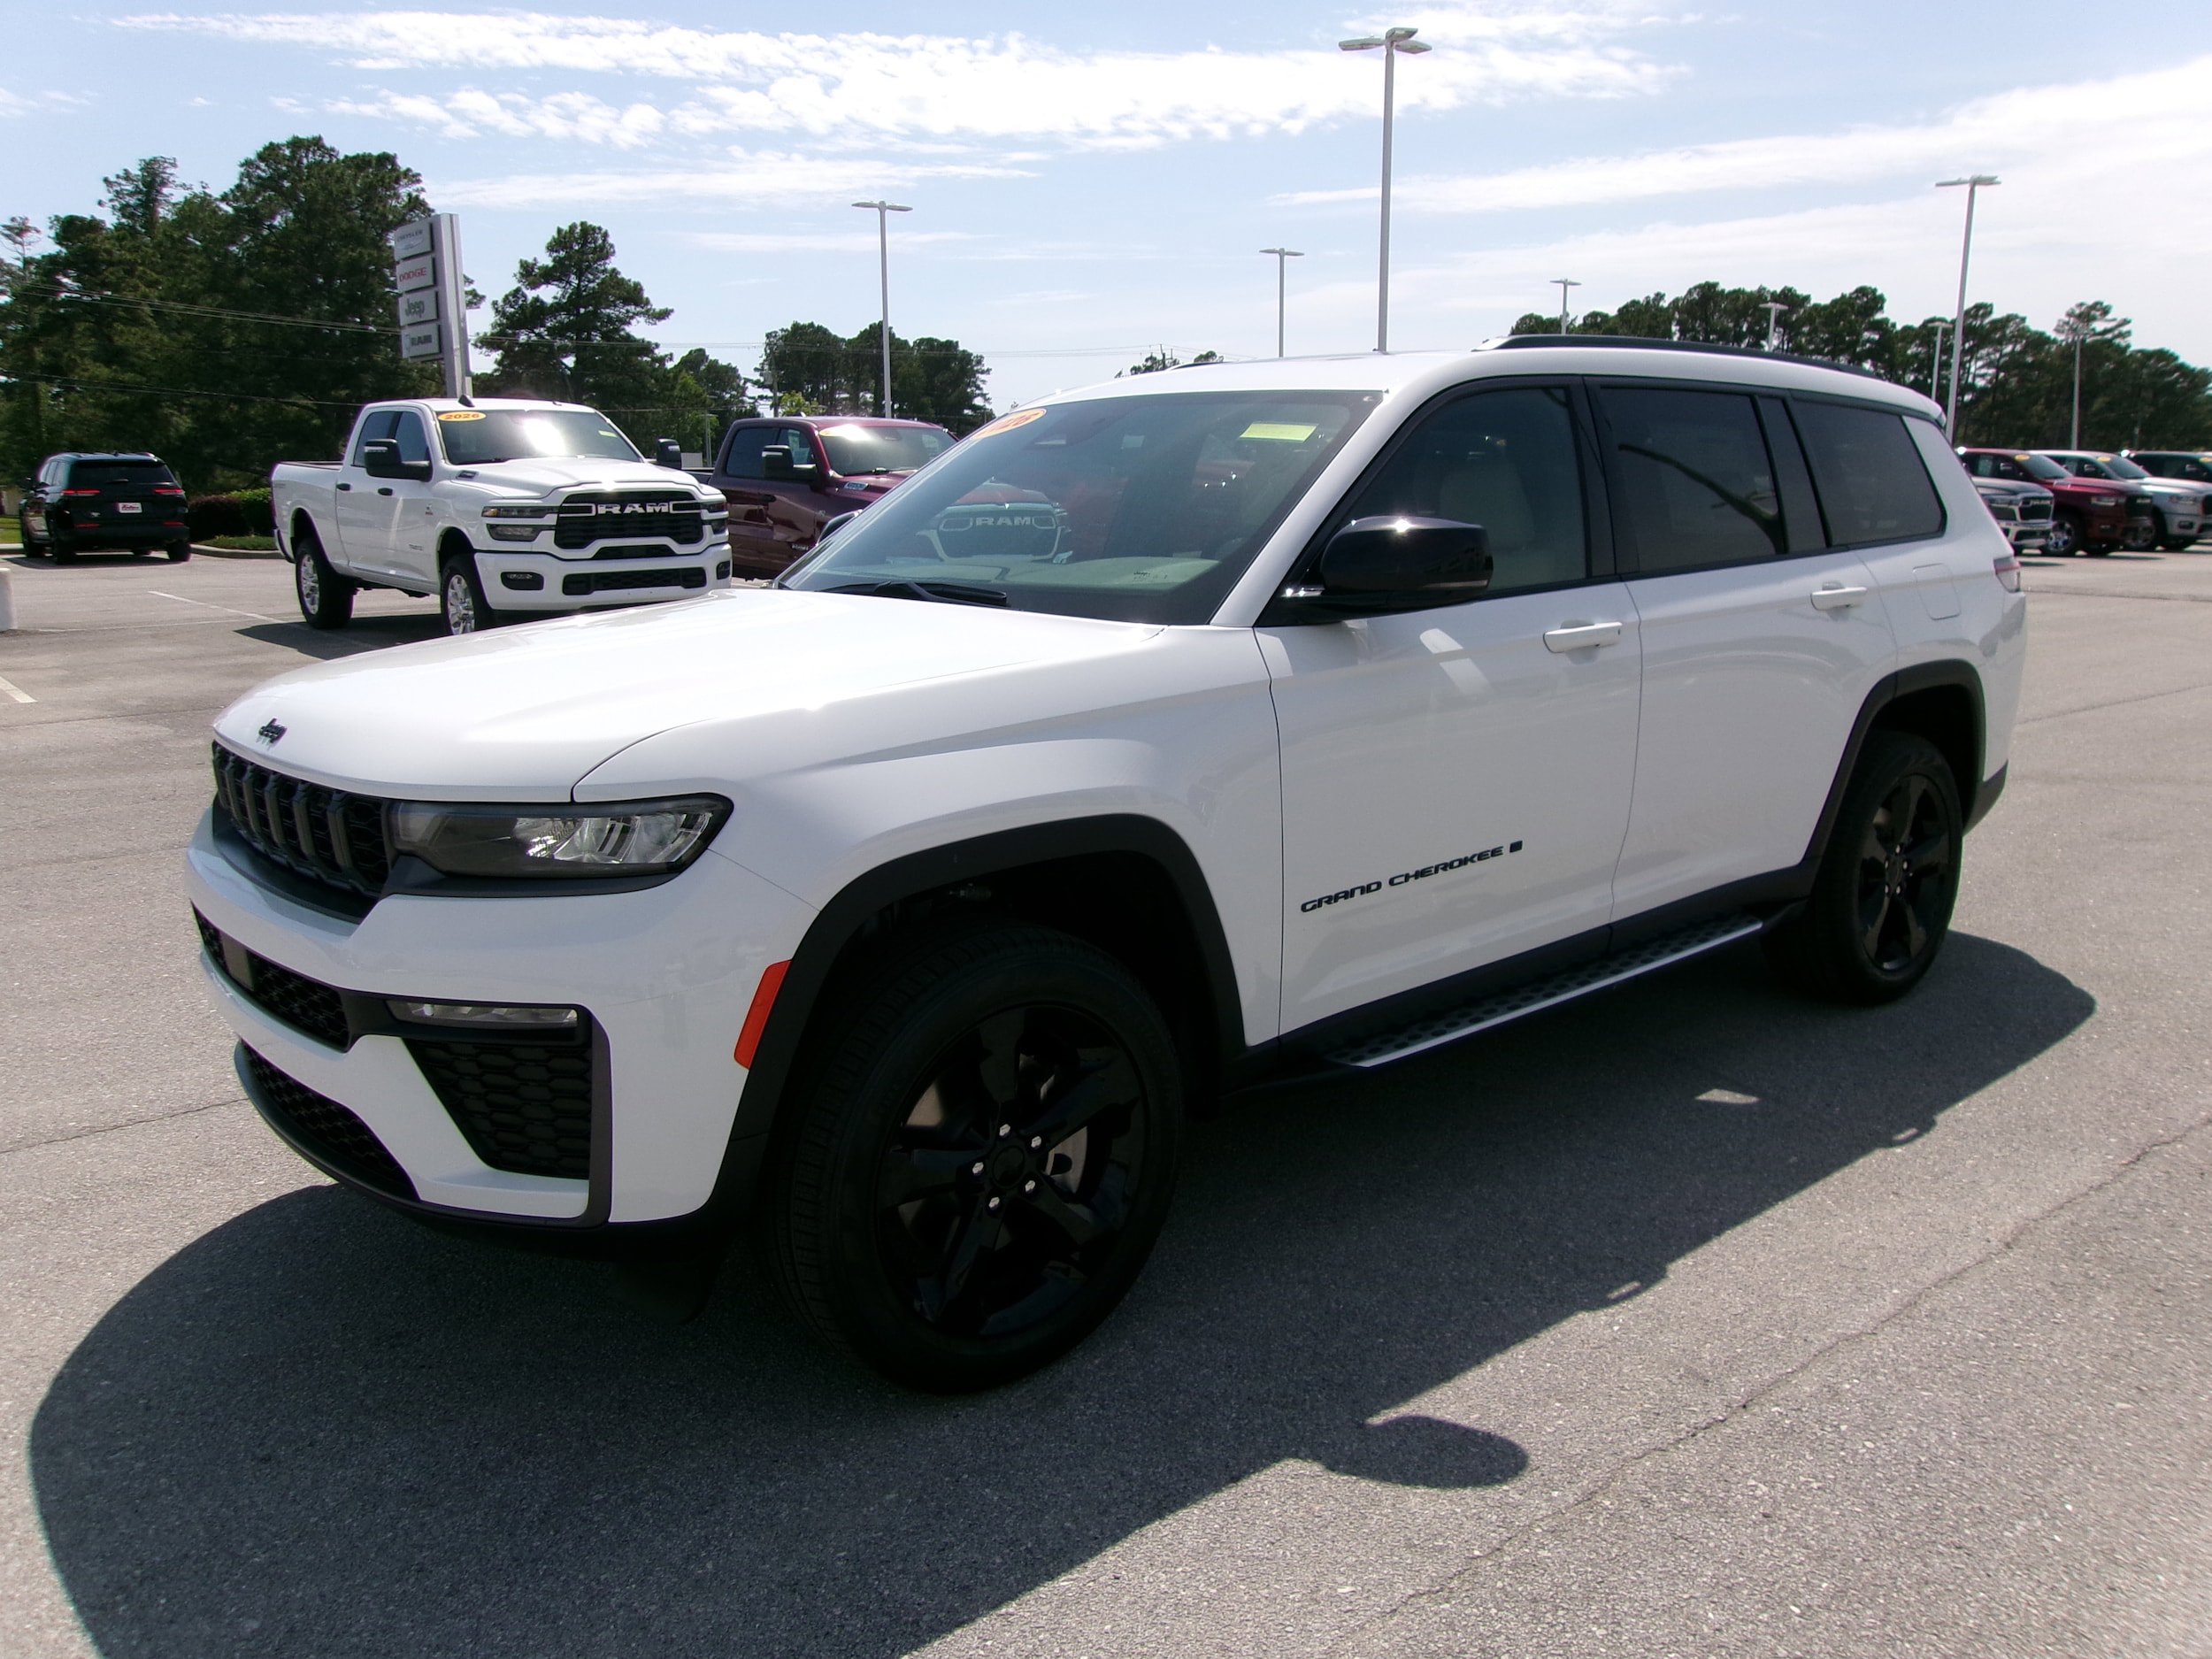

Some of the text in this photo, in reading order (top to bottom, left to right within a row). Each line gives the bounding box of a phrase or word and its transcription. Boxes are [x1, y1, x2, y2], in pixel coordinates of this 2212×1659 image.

[399, 267, 426, 282] DODGE
[405, 298, 425, 319] Jeep
[411, 334, 433, 347] RAM
[597, 502, 669, 514] RAM
[975, 516, 1031, 526] RAM
[258, 718, 288, 744] Jeep
[1301, 846, 1504, 913] GRAND CHEROKEE
